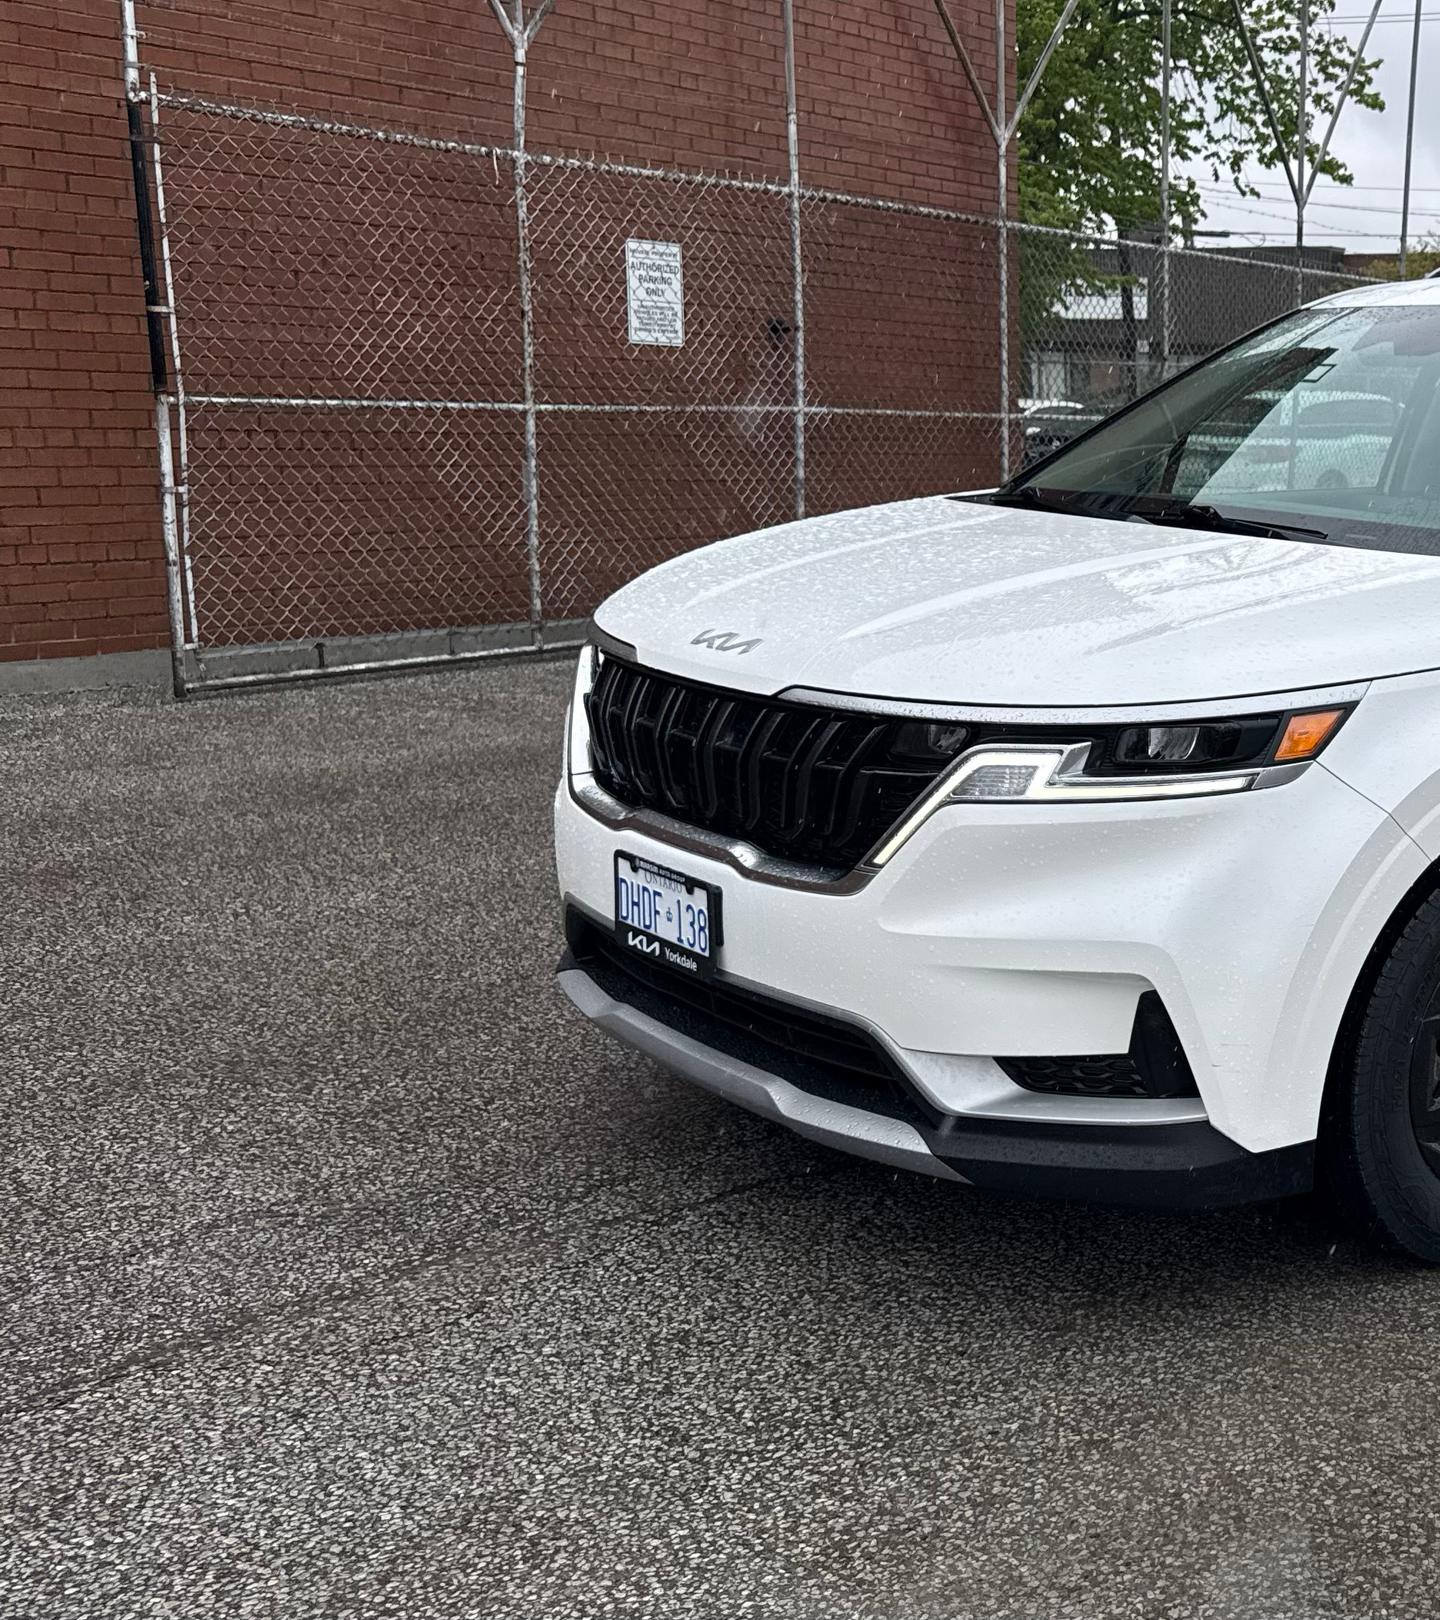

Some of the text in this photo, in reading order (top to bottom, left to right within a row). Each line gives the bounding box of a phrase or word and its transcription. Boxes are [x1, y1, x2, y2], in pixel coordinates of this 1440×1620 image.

[631, 262, 679, 275] AUTHORIZED
[638, 274, 672, 286] PARKING
[645, 287, 665, 297] ONLY
[619, 877, 709, 953] DHDF 138
[664, 946, 698, 972] Yorkdale
